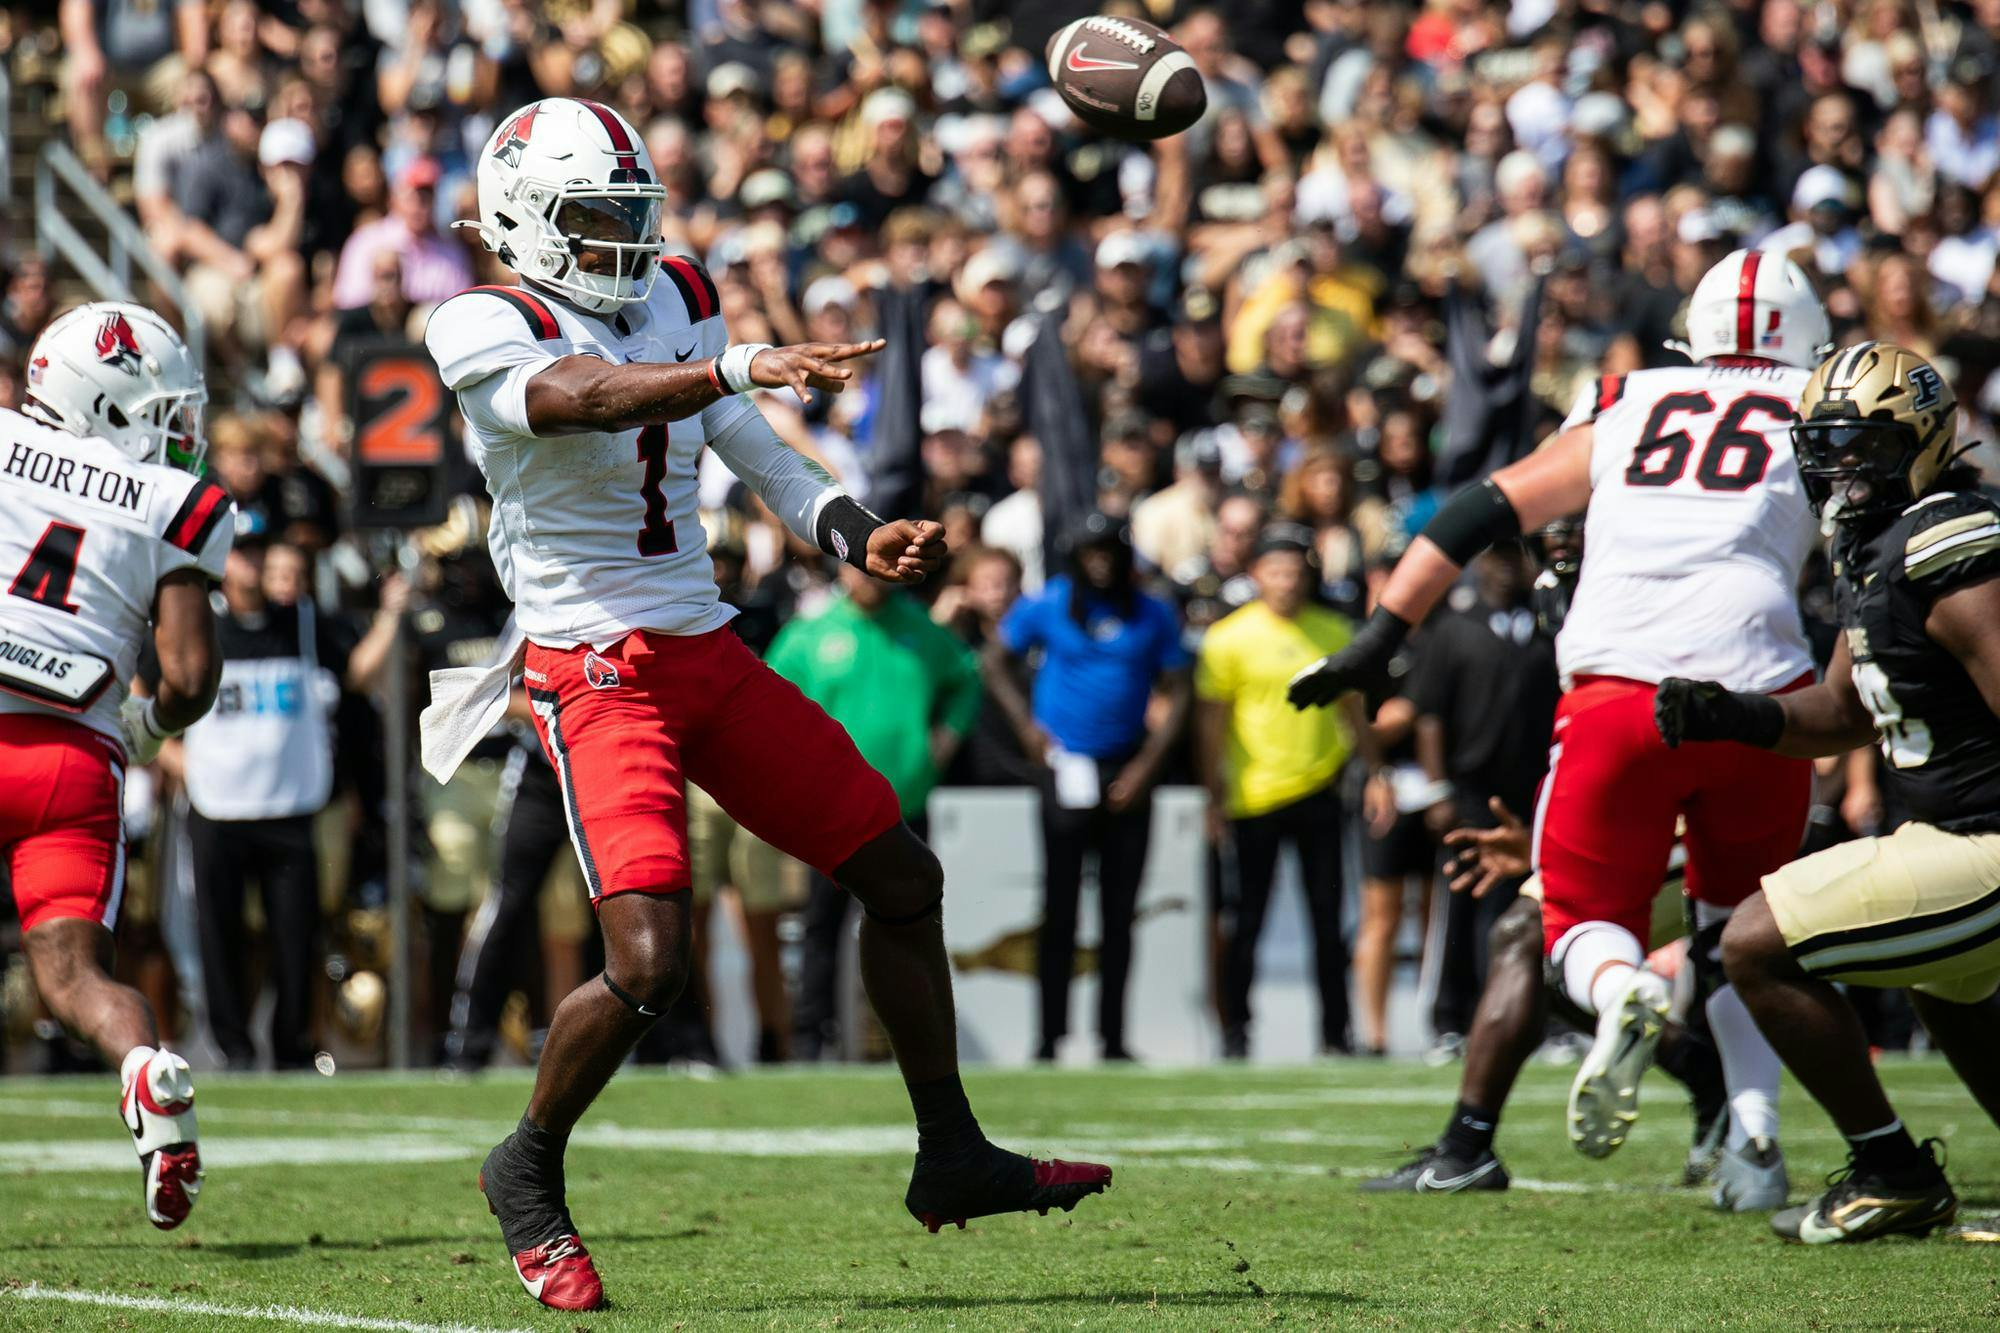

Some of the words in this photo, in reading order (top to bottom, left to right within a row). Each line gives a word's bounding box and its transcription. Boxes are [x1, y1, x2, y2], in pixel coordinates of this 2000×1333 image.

[360, 358, 443, 463] 2
[1905, 363, 1942, 412] P
[4, 442, 145, 511] HORTON
[636, 422, 679, 557] 1
[1624, 390, 1794, 491] 66
[8, 520, 87, 615] 4
